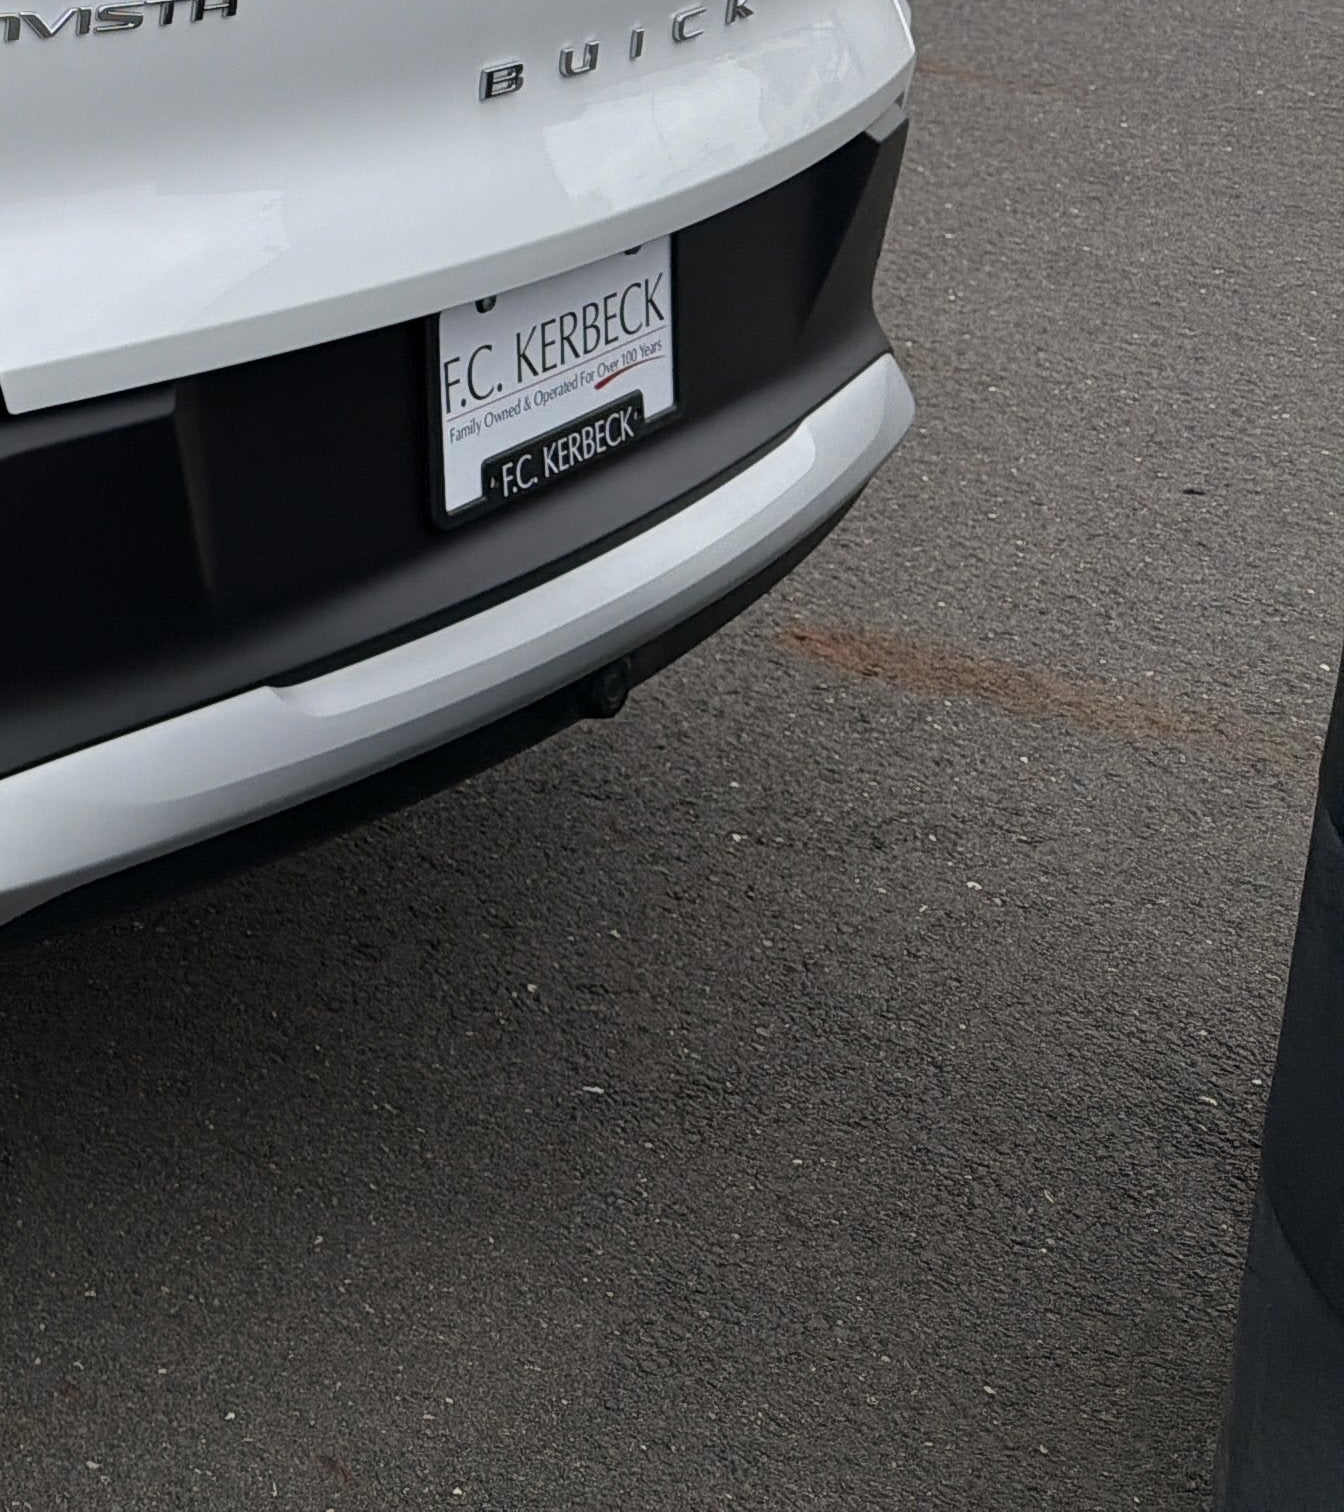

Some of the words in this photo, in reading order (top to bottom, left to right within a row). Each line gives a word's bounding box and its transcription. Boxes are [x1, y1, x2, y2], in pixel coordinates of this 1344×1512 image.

[443, 343, 503, 414] F.C.
[515, 271, 665, 384] KERBECK
[449, 419, 482, 445] Family
[483, 401, 522, 429] Owned
[523, 395, 532, 411] &
[533, 372, 578, 407] Operated
[579, 369, 595, 387] For
[596, 357, 619, 379] Over
[621, 347, 638, 367] 100
[639, 339, 663, 358] Years
[501, 453, 539, 498] F.C.
[542, 406, 635, 478] KERBECK
